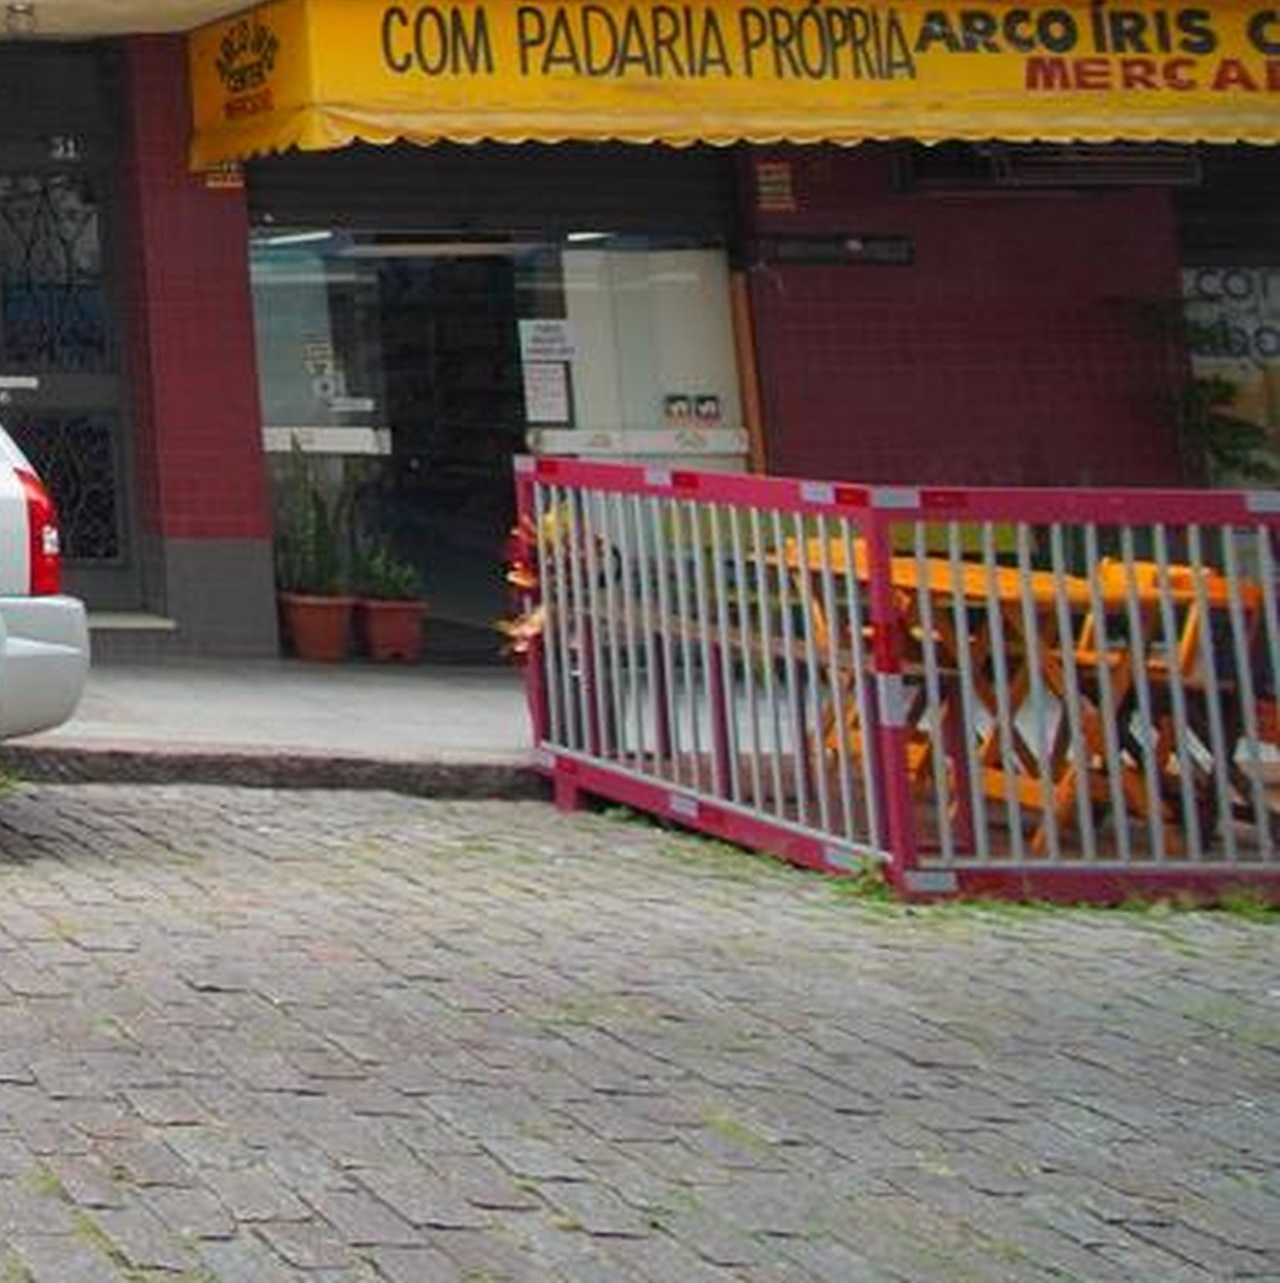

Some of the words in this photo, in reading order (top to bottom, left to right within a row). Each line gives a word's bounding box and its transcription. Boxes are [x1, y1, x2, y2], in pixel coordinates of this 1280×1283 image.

[381, 6, 493, 76] COM
[517, 5, 733, 78] PADARIA
[915, 9, 1078, 53] ARCO
[1091, 0, 1218, 55] ÍRIS
